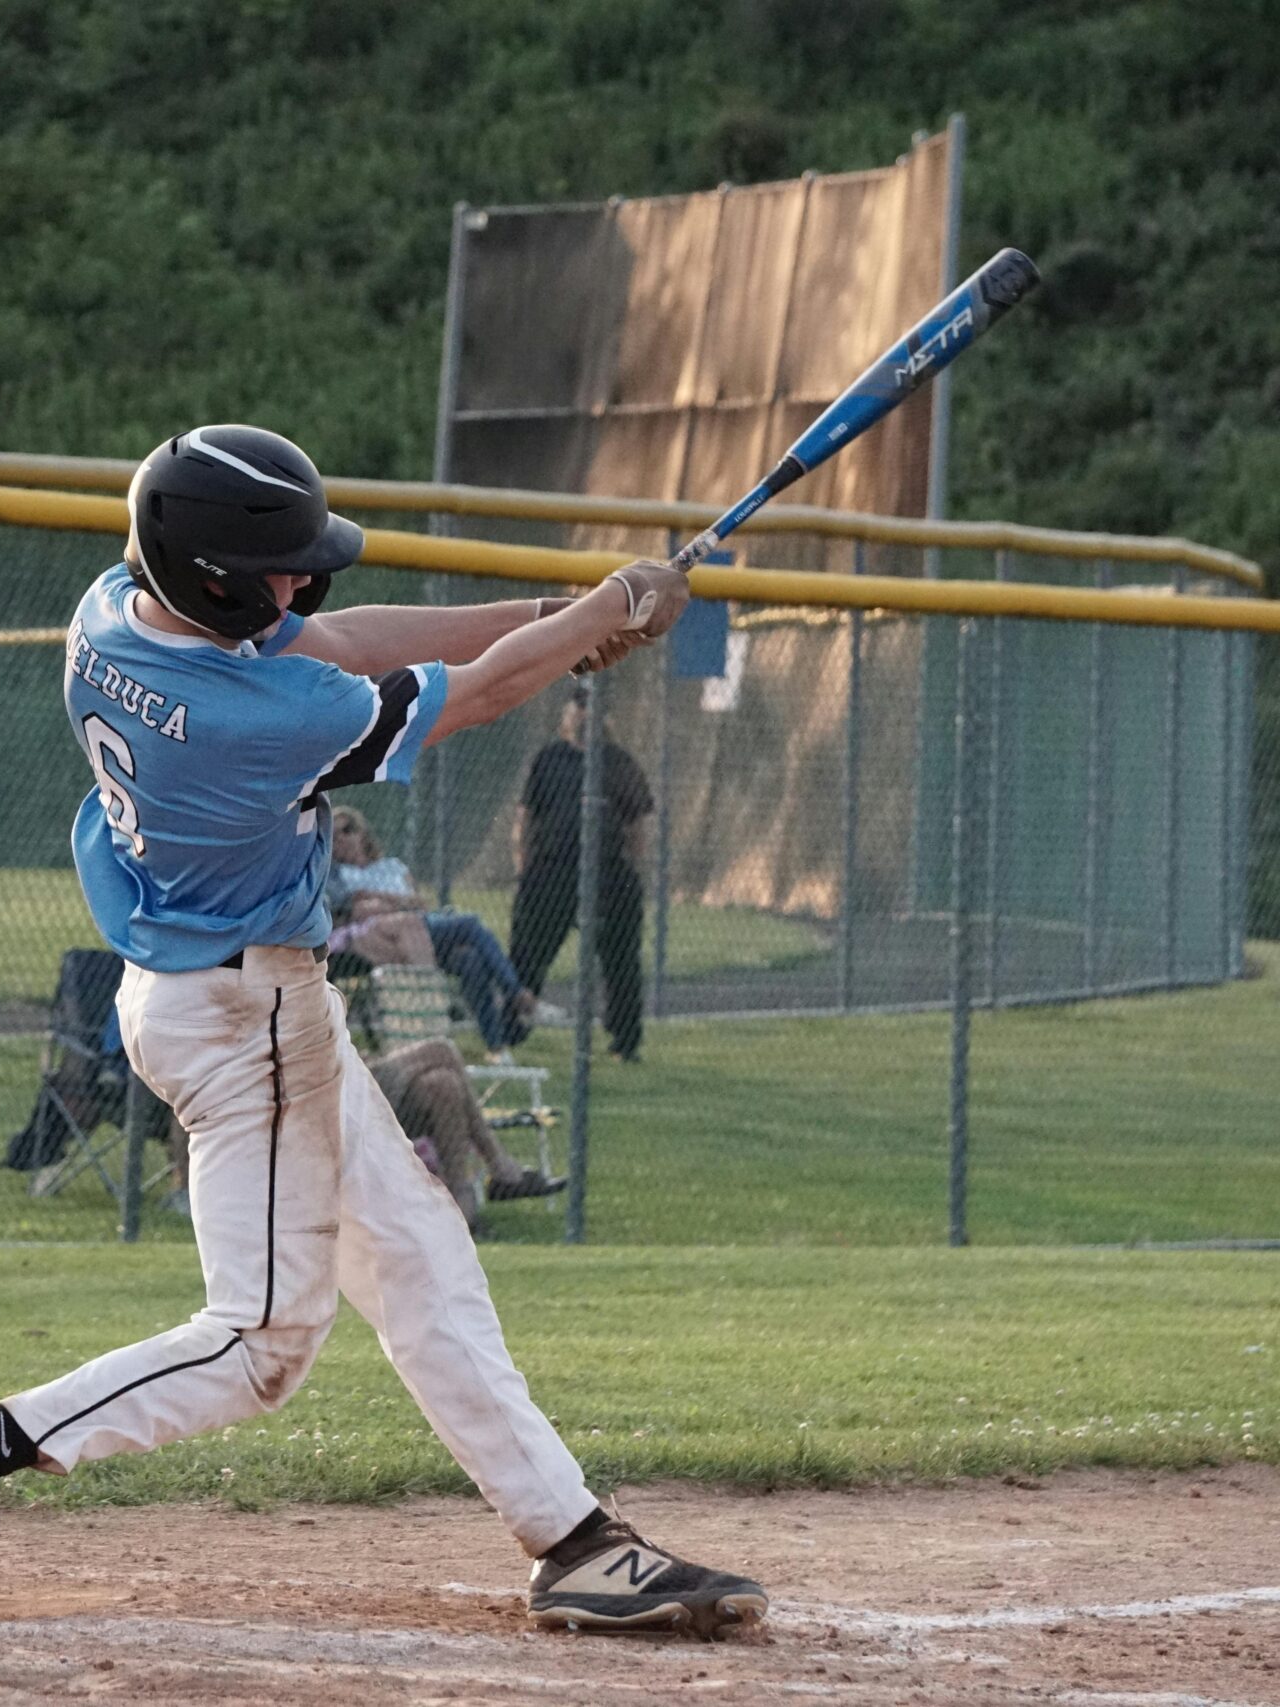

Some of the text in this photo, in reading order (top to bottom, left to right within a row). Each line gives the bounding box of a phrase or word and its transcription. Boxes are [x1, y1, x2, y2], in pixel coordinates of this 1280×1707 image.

[895, 306, 973, 387] META
[193, 557, 227, 576] ELITE
[81, 710, 146, 858] 6
[603, 1548, 665, 1586] N
